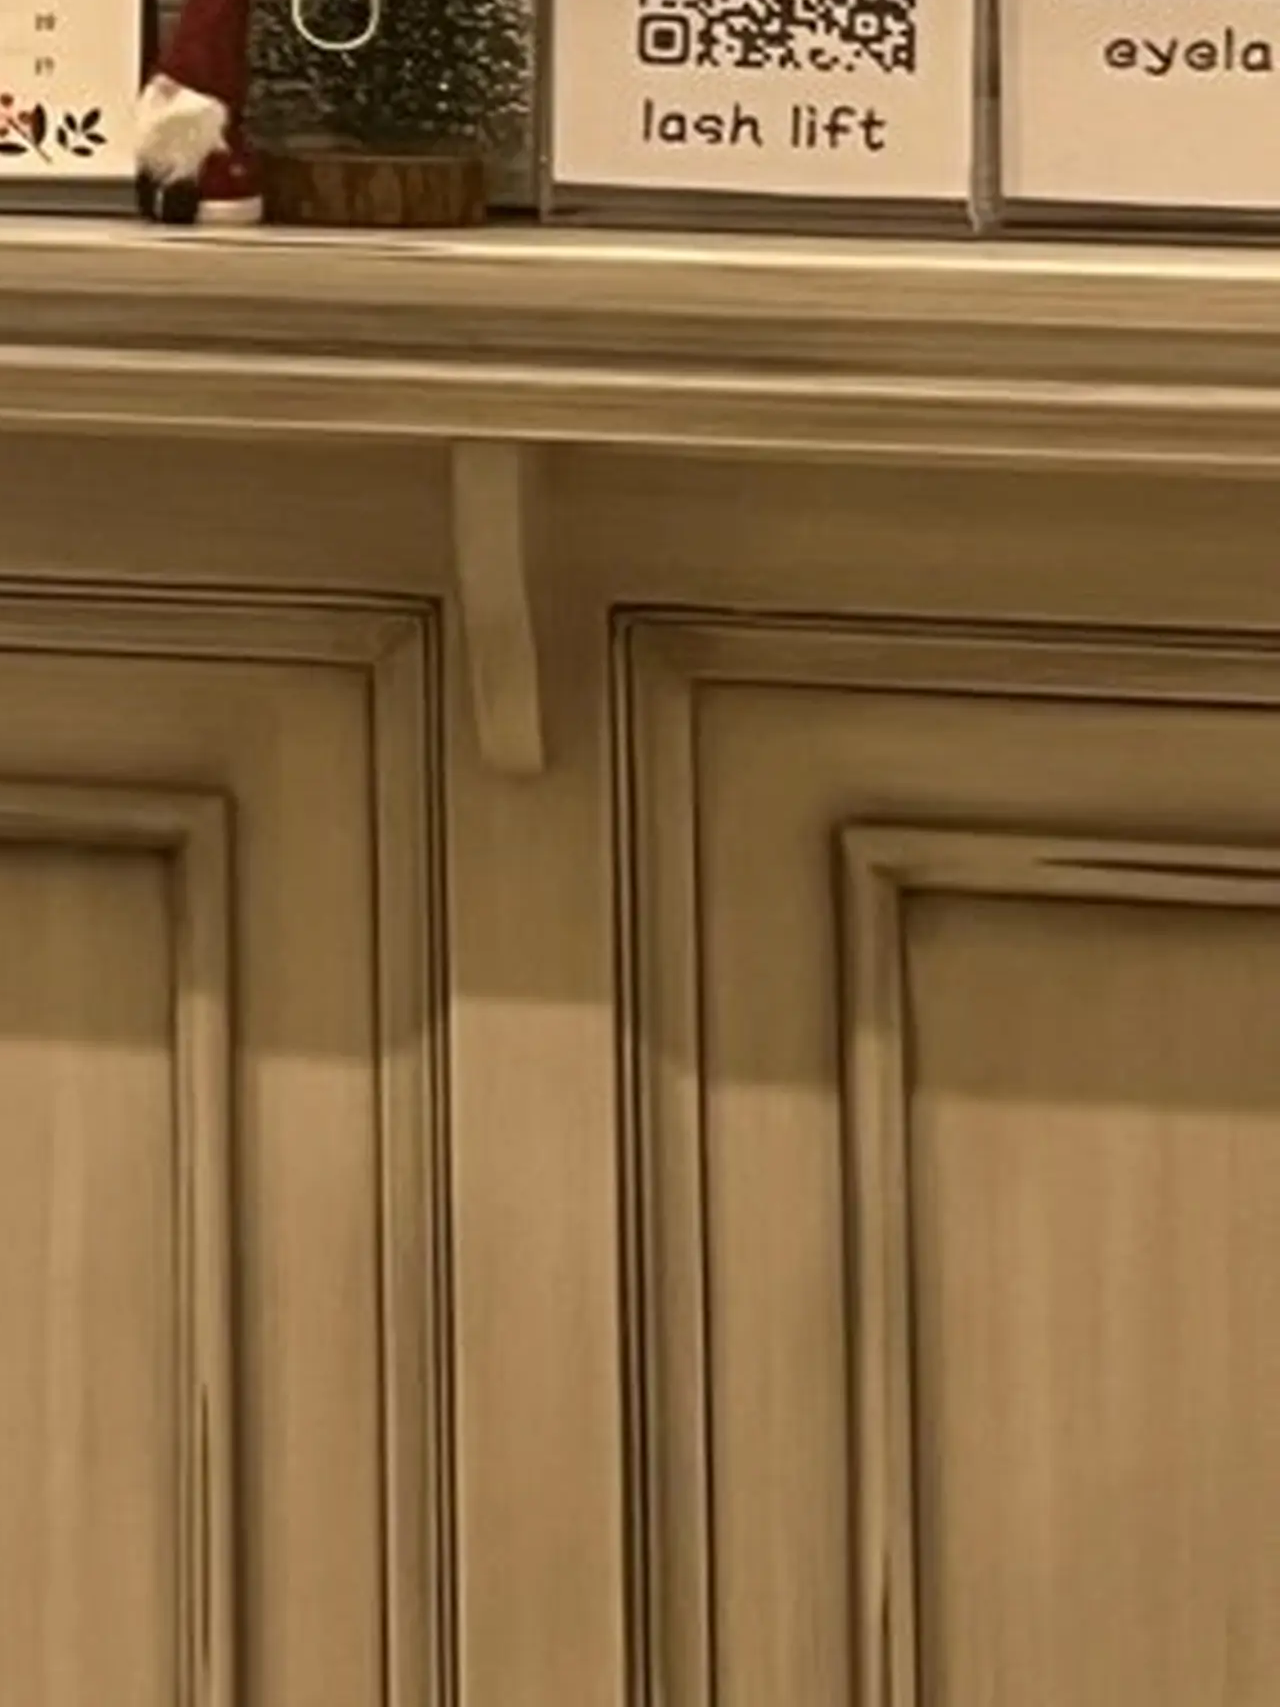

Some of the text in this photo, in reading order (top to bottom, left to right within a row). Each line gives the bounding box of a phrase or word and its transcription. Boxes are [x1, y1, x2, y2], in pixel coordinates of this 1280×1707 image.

[1103, 25, 1274, 77] eyela
[641, 97, 888, 153] lash lift
